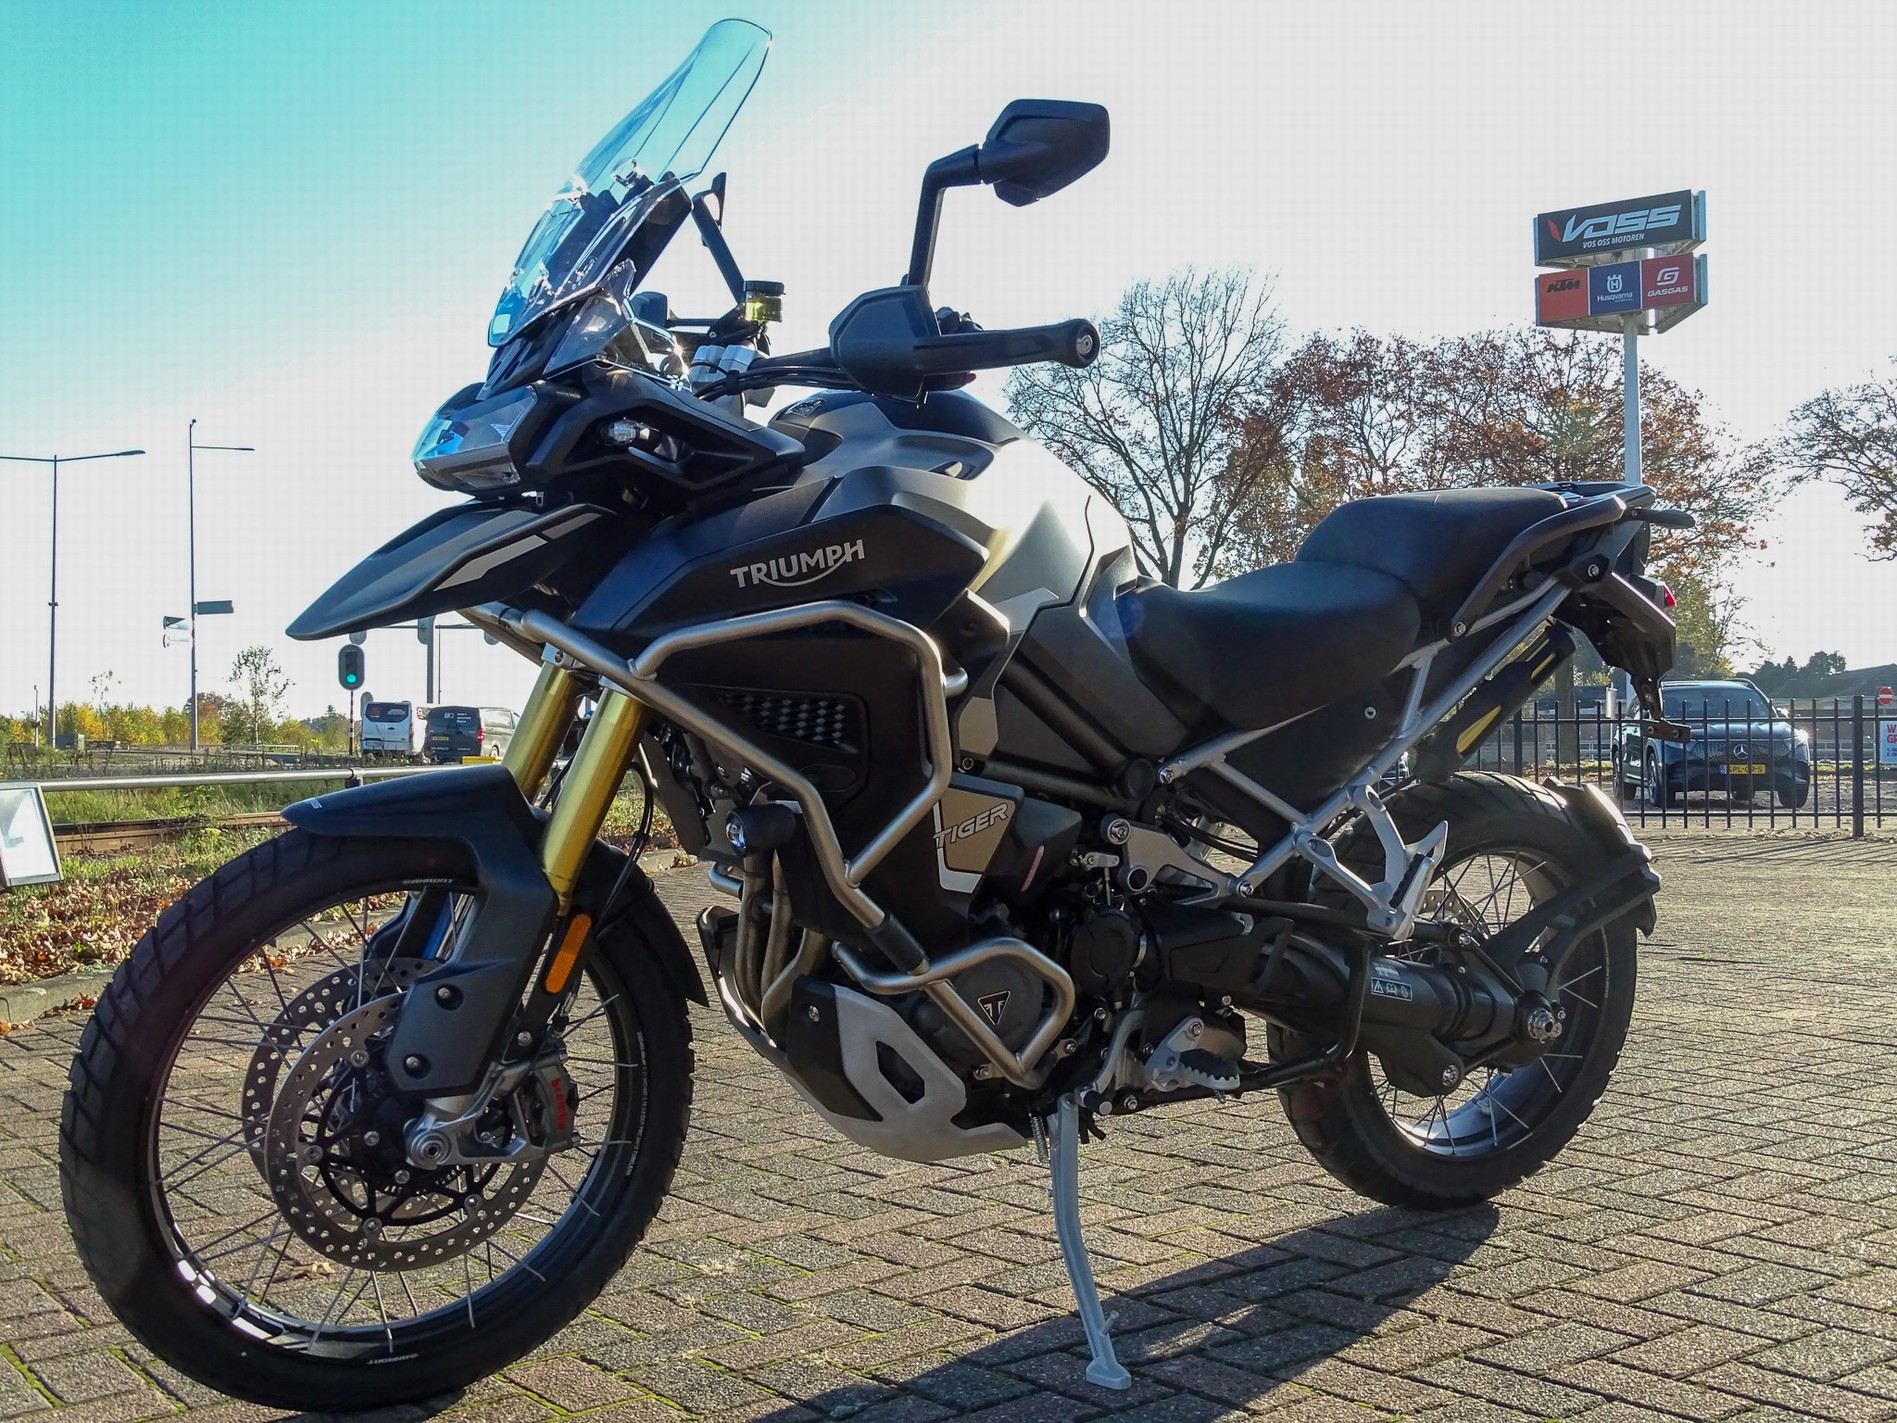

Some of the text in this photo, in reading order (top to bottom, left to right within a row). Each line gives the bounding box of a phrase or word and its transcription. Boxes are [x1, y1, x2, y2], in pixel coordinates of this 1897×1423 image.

[1562, 204, 1682, 242] VOSS
[1582, 233, 1645, 249] VOS OSS MOTOREN
[1547, 278, 1580, 293] KTM
[1647, 285, 1689, 298] GASGAS
[1597, 292, 1633, 302] Husqvarna
[729, 538, 865, 589] TRIUMPH
[933, 802, 1009, 847] TIGER
